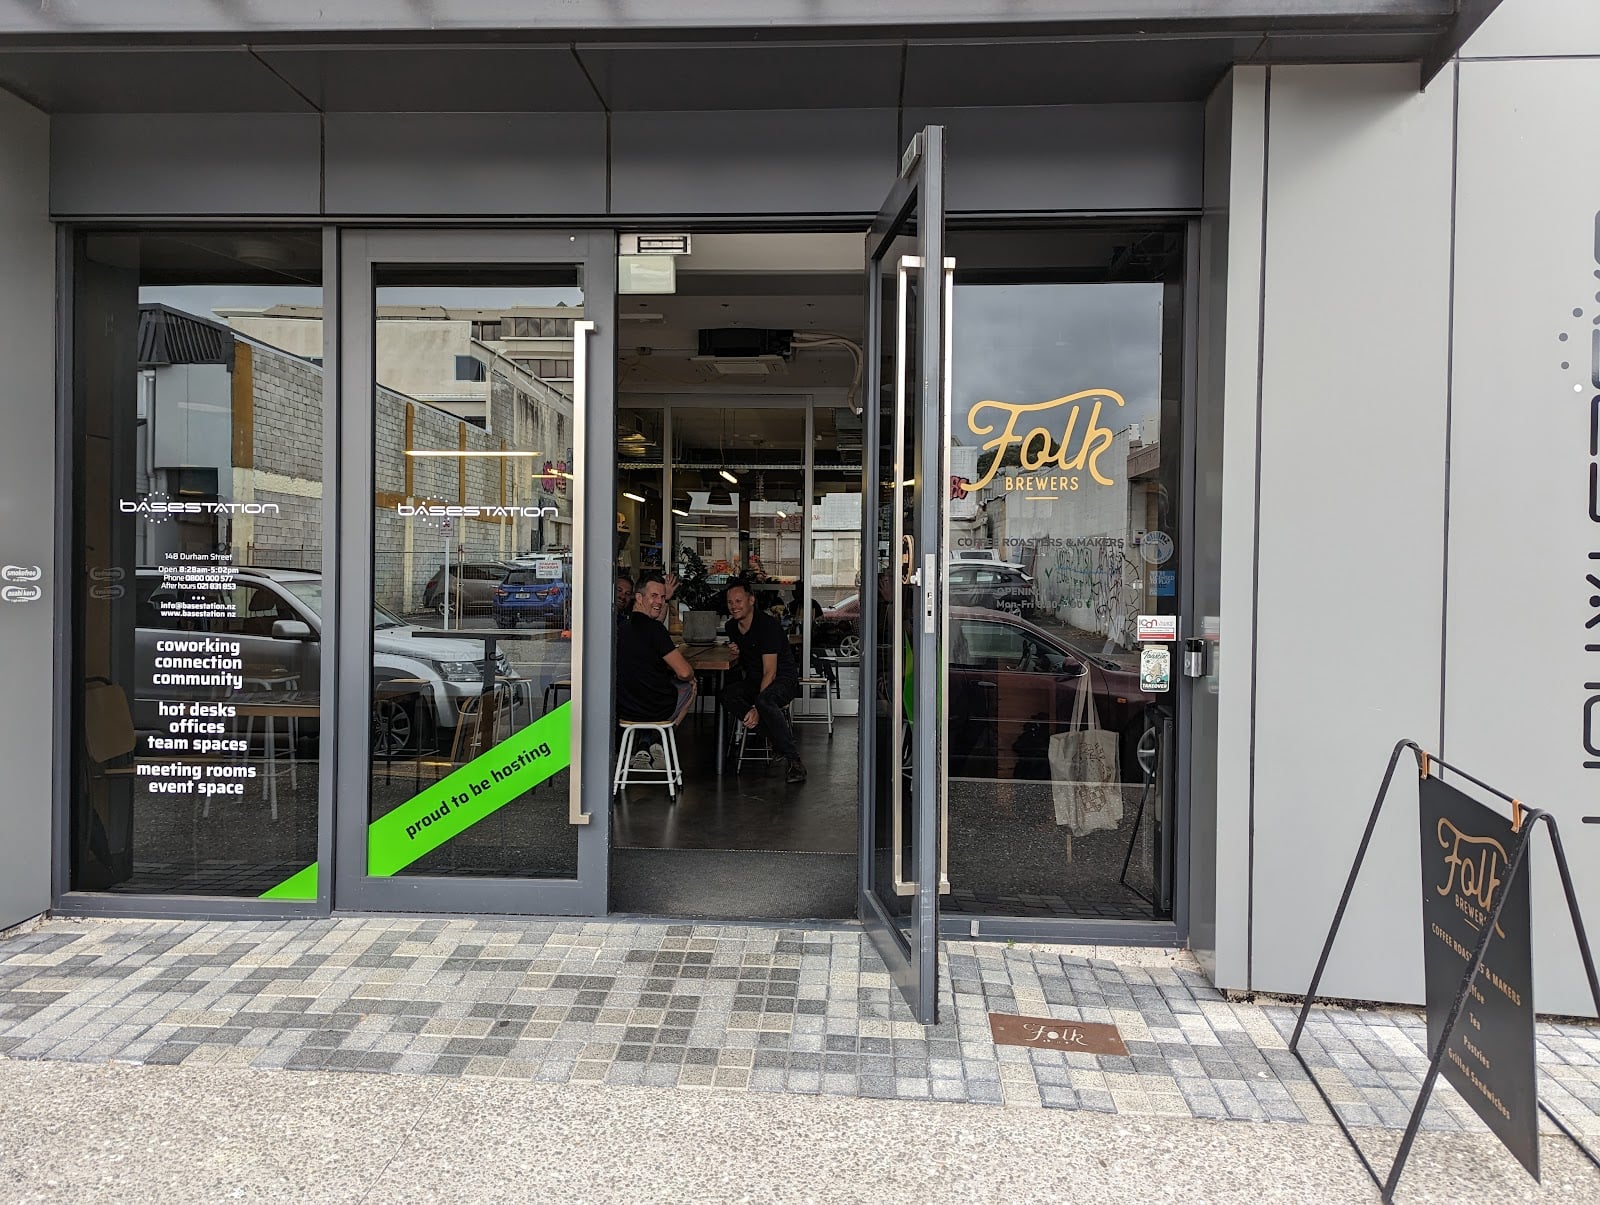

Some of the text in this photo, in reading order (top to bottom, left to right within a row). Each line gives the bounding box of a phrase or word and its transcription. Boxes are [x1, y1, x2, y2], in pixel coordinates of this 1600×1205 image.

[961, 388, 1125, 492] Folk
[1005, 476, 1079, 491] BREWERS
[957, 537, 1125, 548] COFFEE ROASTERS & MAKERS
[164, 552, 233, 561] 148 Durham Street
[158, 566, 239, 575] Open 8:28am-5:02pm
[163, 574, 185, 582] Phone
[185, 574, 204, 582] 0800
[197, 582, 209, 590] 021
[997, 587, 1040, 596] OPENIN
[160, 601, 237, 610] info@basestation.nz
[160, 610, 237, 618] www.basestationnz
[156, 638, 241, 656] coworking
[155, 655, 243, 670] connection
[153, 671, 243, 689] community
[158, 701, 237, 717] hot desks
[169, 719, 225, 734] offices
[147, 735, 248, 753] team spaces
[136, 762, 257, 780] meeting rooms
[148, 780, 244, 797] event space
[405, 742, 552, 840] proud to be hosting
[1431, 922, 1453, 947] COFFEE
[1492, 973, 1521, 1006] MAKERS
[1469, 1011, 1481, 1031] Tea
[1463, 1034, 1490, 1069] Pastries
[1448, 1047, 1511, 1120] Grilled Sandwiches
